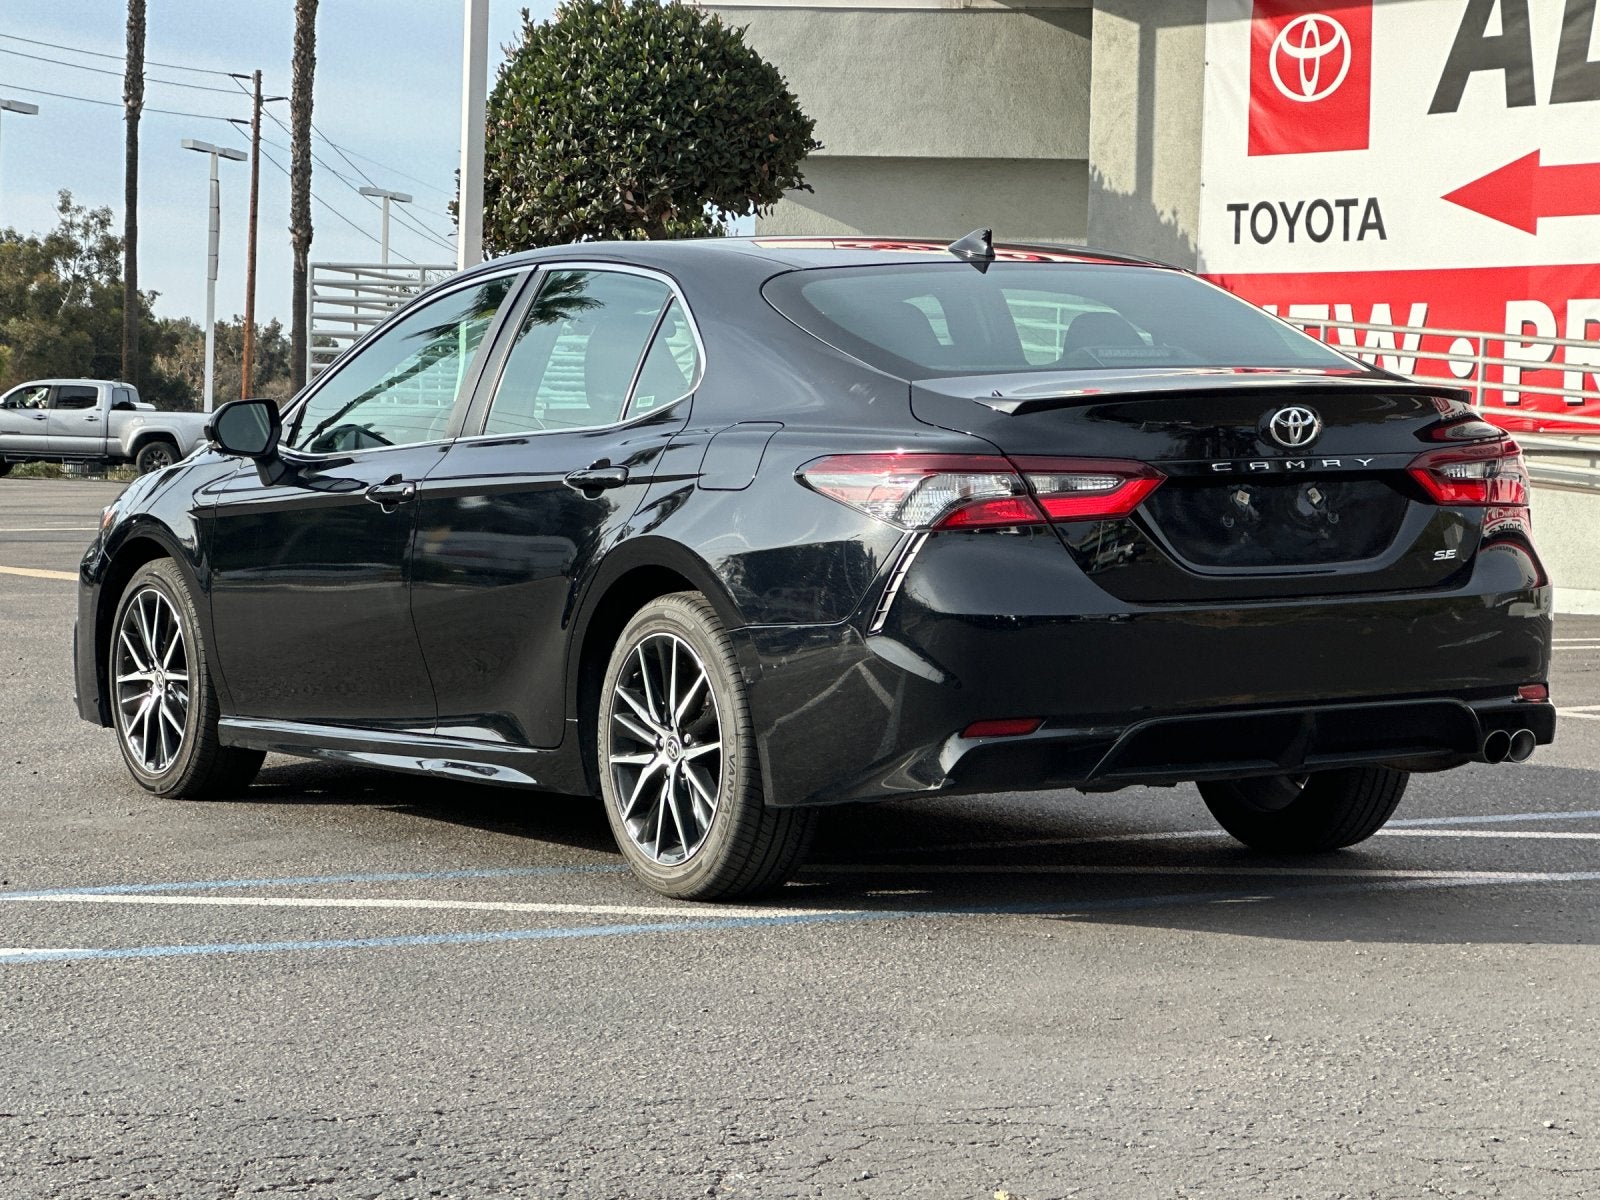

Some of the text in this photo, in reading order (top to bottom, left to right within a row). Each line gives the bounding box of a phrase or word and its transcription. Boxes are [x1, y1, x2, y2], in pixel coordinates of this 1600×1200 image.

[1226, 197, 1388, 245] TOYOTA
[1211, 457, 1374, 473] CAMRY
[1432, 548, 1457, 562] SE
